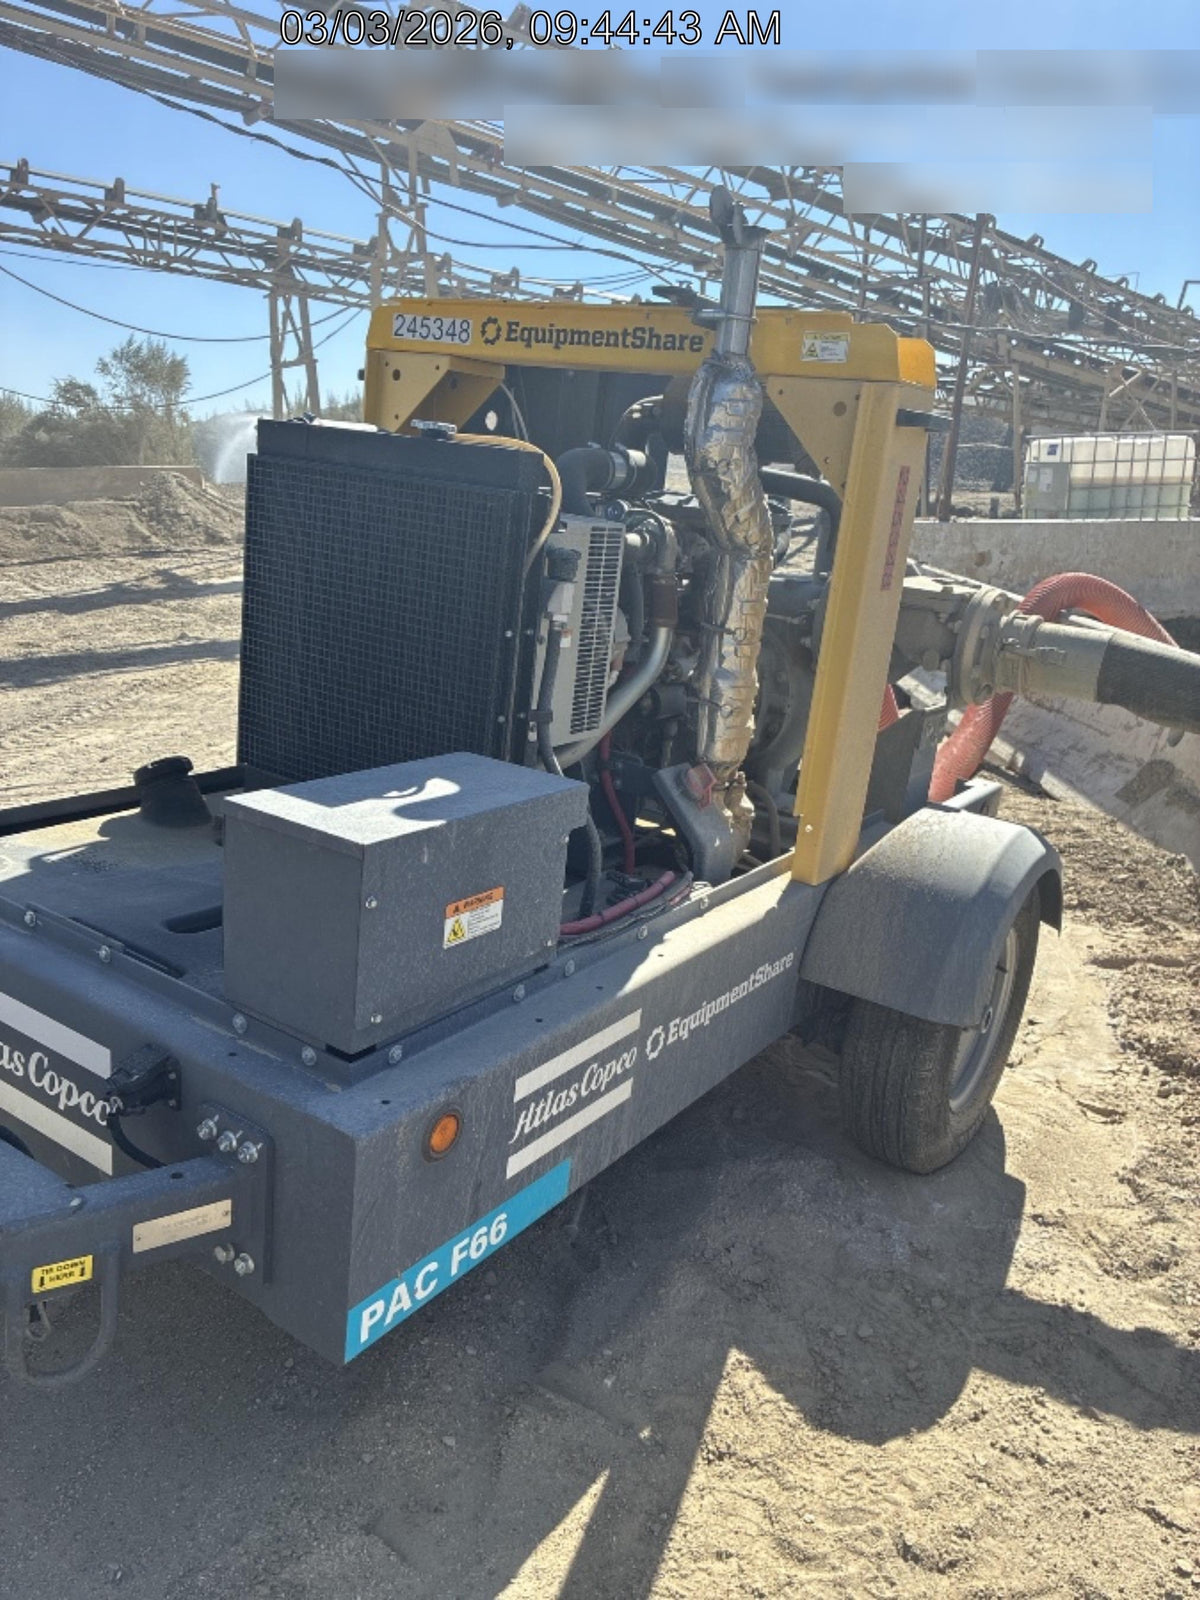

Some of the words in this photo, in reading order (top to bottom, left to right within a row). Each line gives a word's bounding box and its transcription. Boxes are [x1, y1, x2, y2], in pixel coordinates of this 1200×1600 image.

[393, 313, 471, 343] 245348
[505, 321, 704, 352] EquipmentShare
[666, 952, 794, 1046] EquipmentShare
[508, 1081, 580, 1145] Atlas
[580, 1046, 638, 1097] Copco
[360, 1261, 438, 1344] PAC
[451, 1212, 508, 1277] F66
